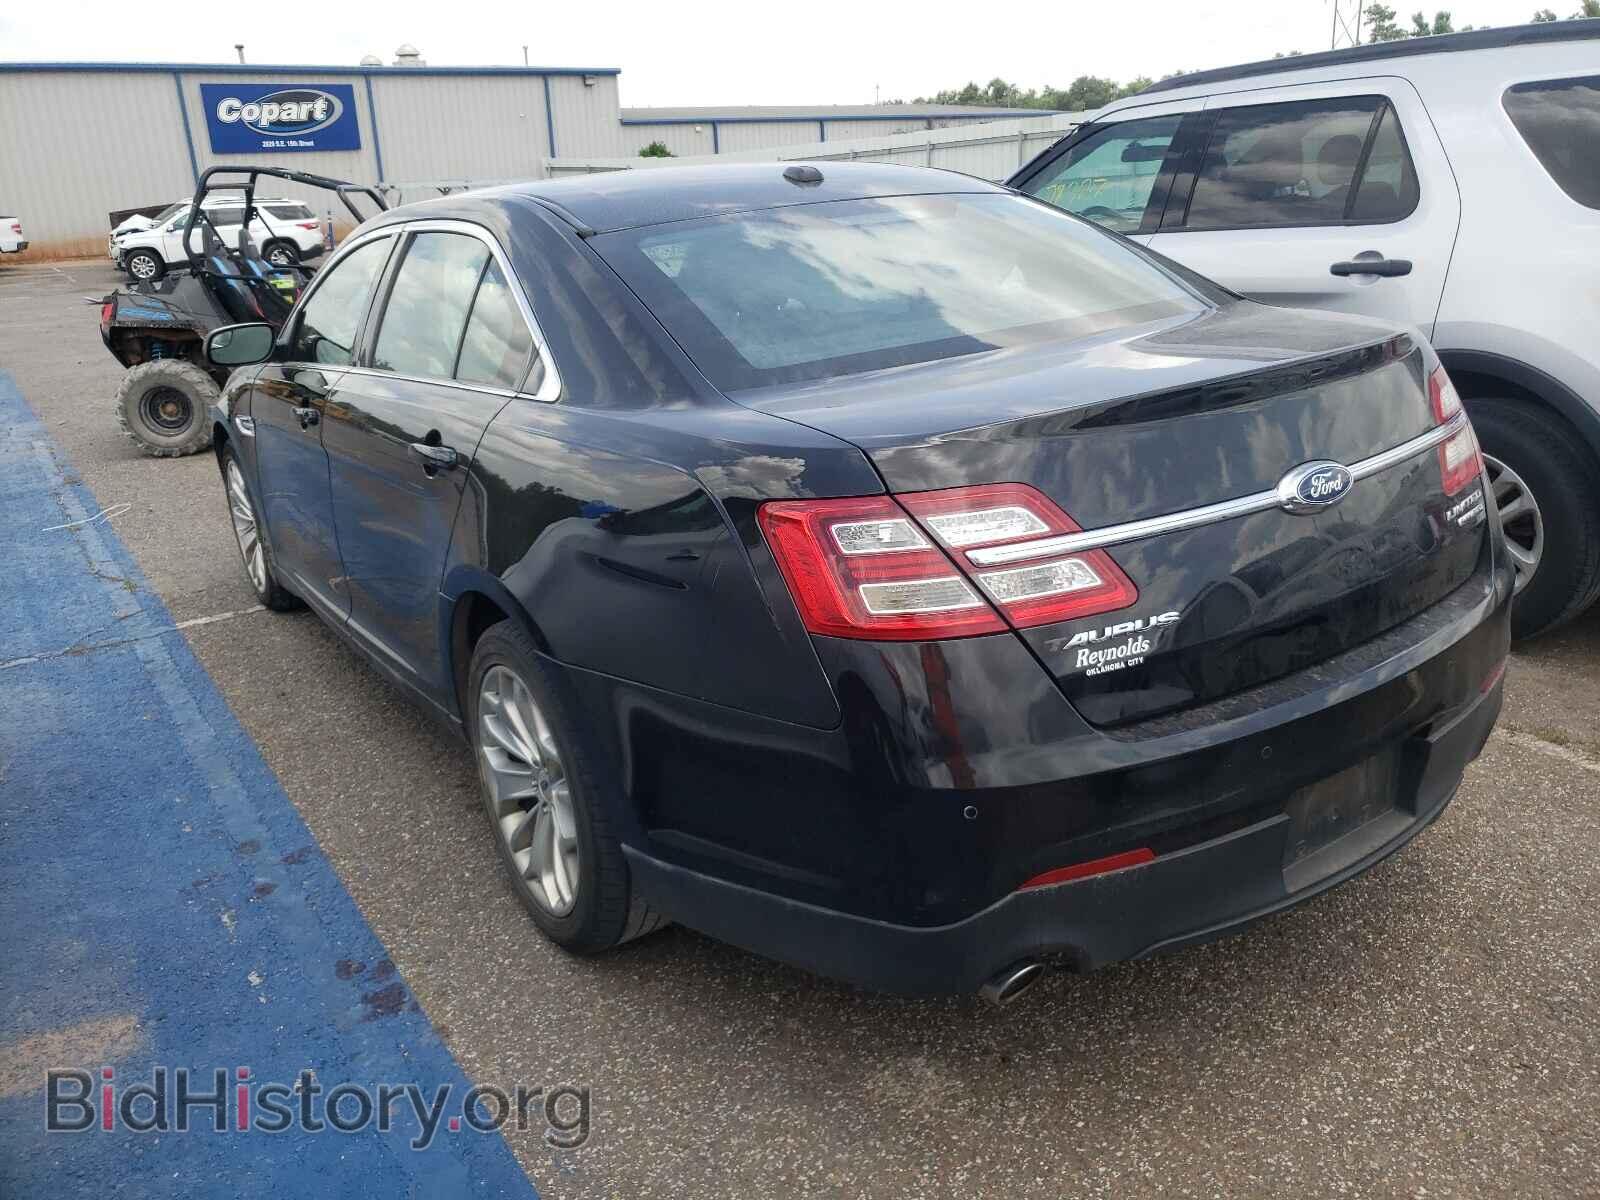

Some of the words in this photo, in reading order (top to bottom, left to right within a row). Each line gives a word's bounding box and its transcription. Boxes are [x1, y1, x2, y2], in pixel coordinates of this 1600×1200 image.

[217, 96, 328, 127] Copart
[1310, 472, 1343, 497] Ford
[1445, 489, 1482, 521] LIMITED
[1075, 635, 1150, 668] Reynolds
[1086, 661, 1126, 676] OKLAHOMA
[1127, 656, 1145, 667] CITY
